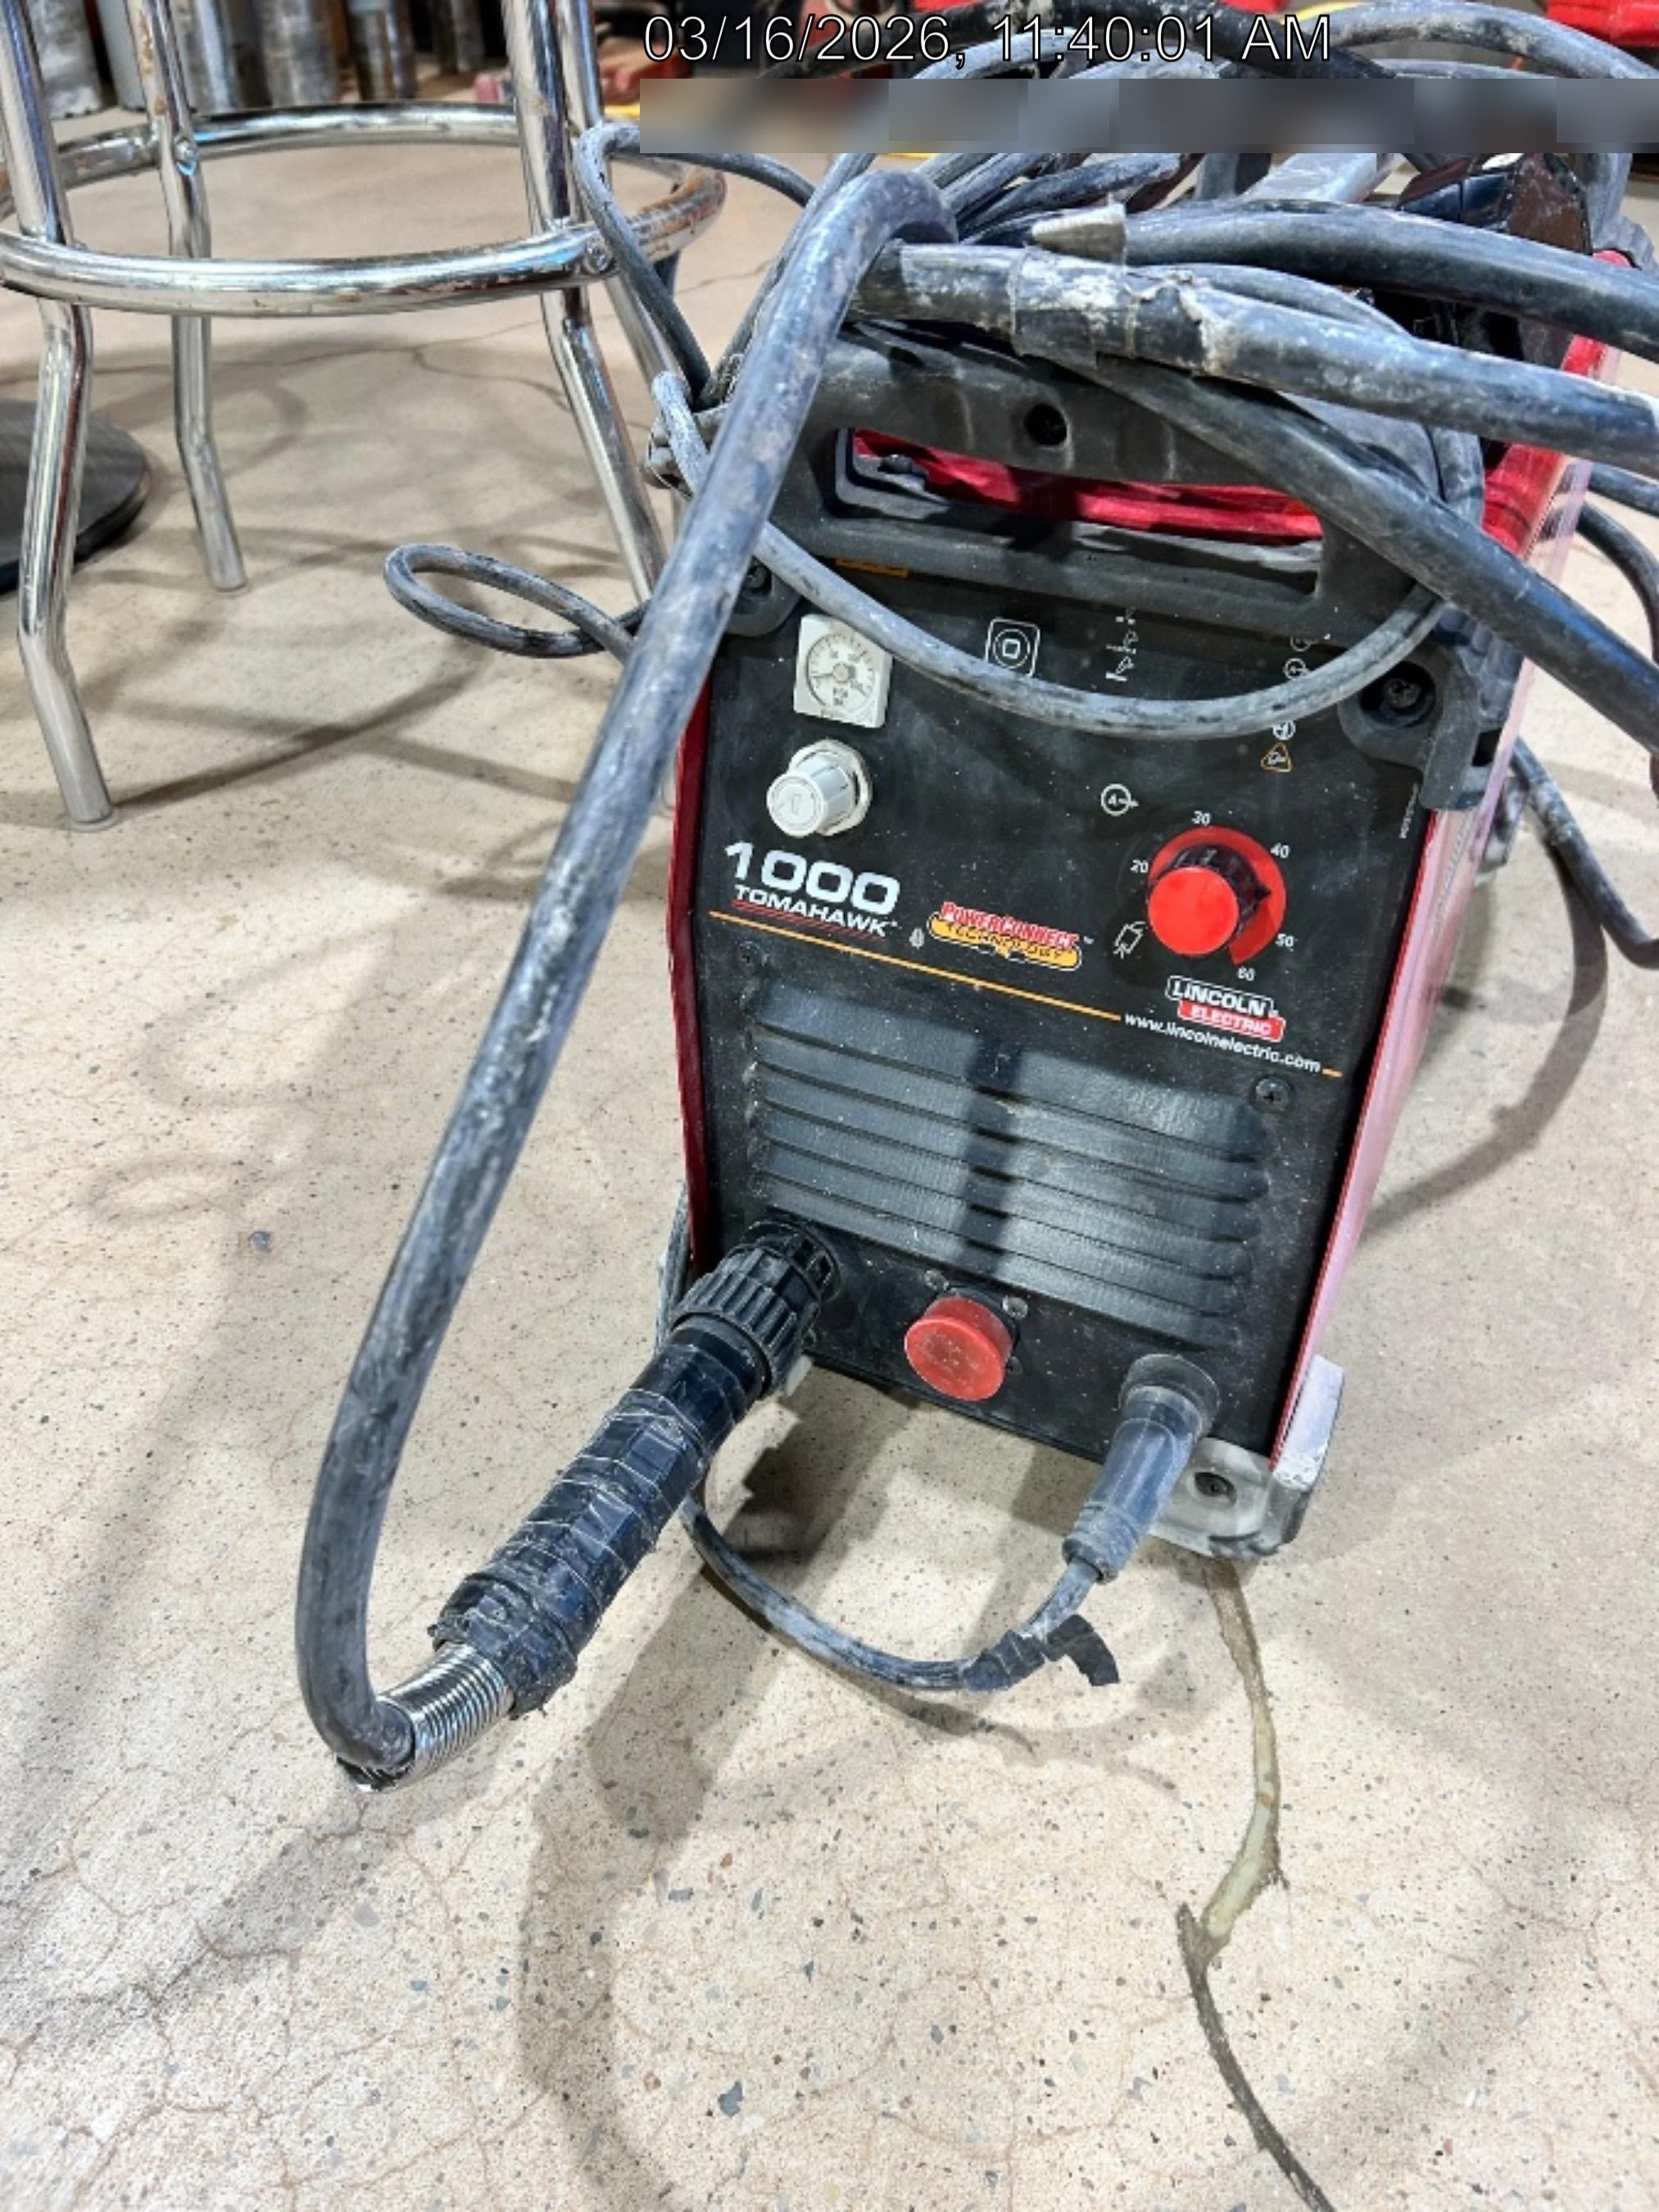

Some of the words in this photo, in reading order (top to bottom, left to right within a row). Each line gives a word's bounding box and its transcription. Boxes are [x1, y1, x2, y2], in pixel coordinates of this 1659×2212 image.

[1193, 811, 1211, 825] 30
[1131, 859, 1148, 873] 20
[1271, 842, 1290, 859] 40
[725, 840, 900, 915] 1000
[734, 884, 891, 937] TOMAHAWK
[1172, 981, 1267, 1017] LINCOLN
[1190, 1004, 1271, 1036] ELECTRIC
[1125, 1013, 1321, 1072] www.lincolnelectric.com
